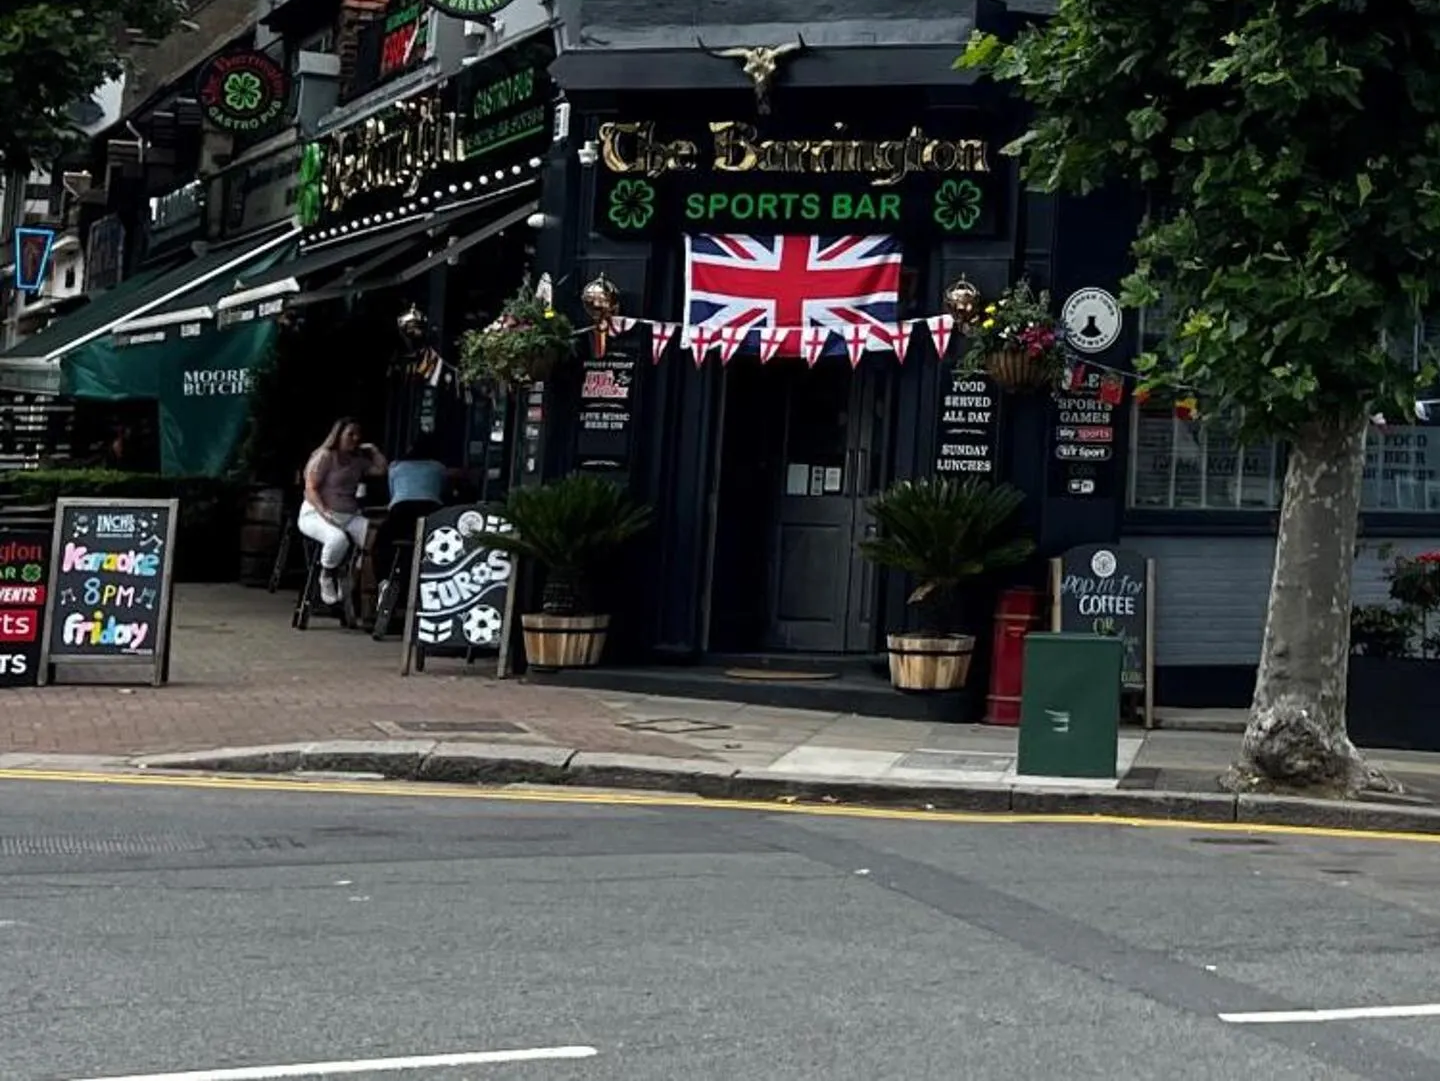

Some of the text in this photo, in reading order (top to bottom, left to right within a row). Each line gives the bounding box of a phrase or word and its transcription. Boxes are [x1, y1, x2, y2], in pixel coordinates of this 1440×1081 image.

[599, 121, 698, 178] The
[709, 120, 992, 187] Barrington
[685, 192, 902, 220] SPORTS BAR
[183, 383, 246, 397] BUTCH
[952, 381, 987, 392] FOOD
[944, 395, 992, 408] SERVED
[942, 410, 992, 423] ALL DAY
[1060, 411, 1111, 424] GAMES
[941, 443, 989, 457] SUNDAY
[936, 459, 992, 472] LUNCHES
[62, 542, 160, 577] Karaoke
[1079, 594, 1136, 616] COFFEE
